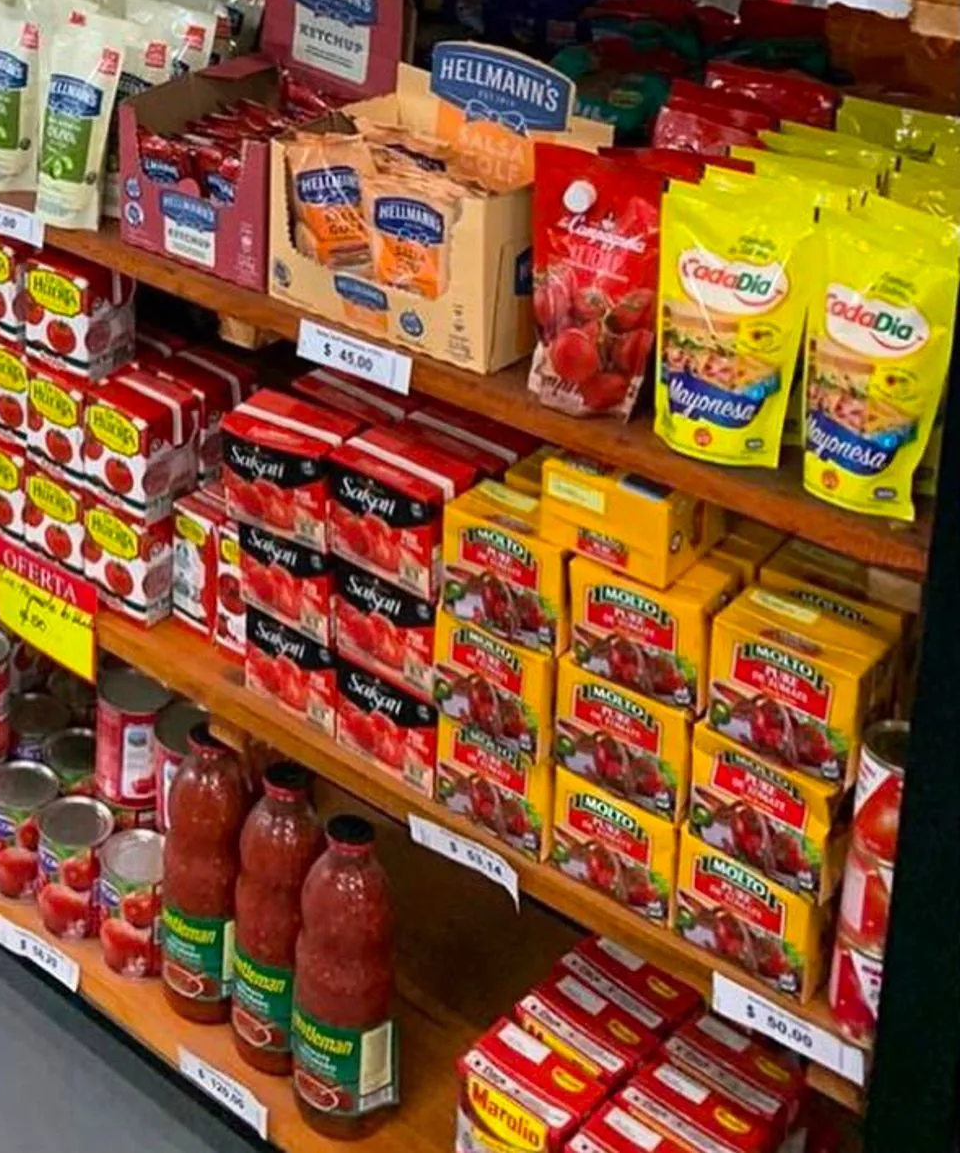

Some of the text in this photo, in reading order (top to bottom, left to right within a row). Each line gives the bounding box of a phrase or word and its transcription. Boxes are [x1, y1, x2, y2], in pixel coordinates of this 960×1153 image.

[299, 22, 364, 55] KETCHUP
[438, 55, 561, 113] HELLMANN'S
[324, 343, 332, 358] $
[669, 377, 758, 422] Mayonesa
[2, 547, 78, 605] OFERTA
[605, 586, 657, 616] MOLTO
[755, 644, 814, 678] MOLTO
[592, 685, 644, 719] MOLTO
[583, 793, 635, 831] MOLTO
[713, 858, 767, 897] MOLTO
[471, 1079, 541, 1147] Marolio
